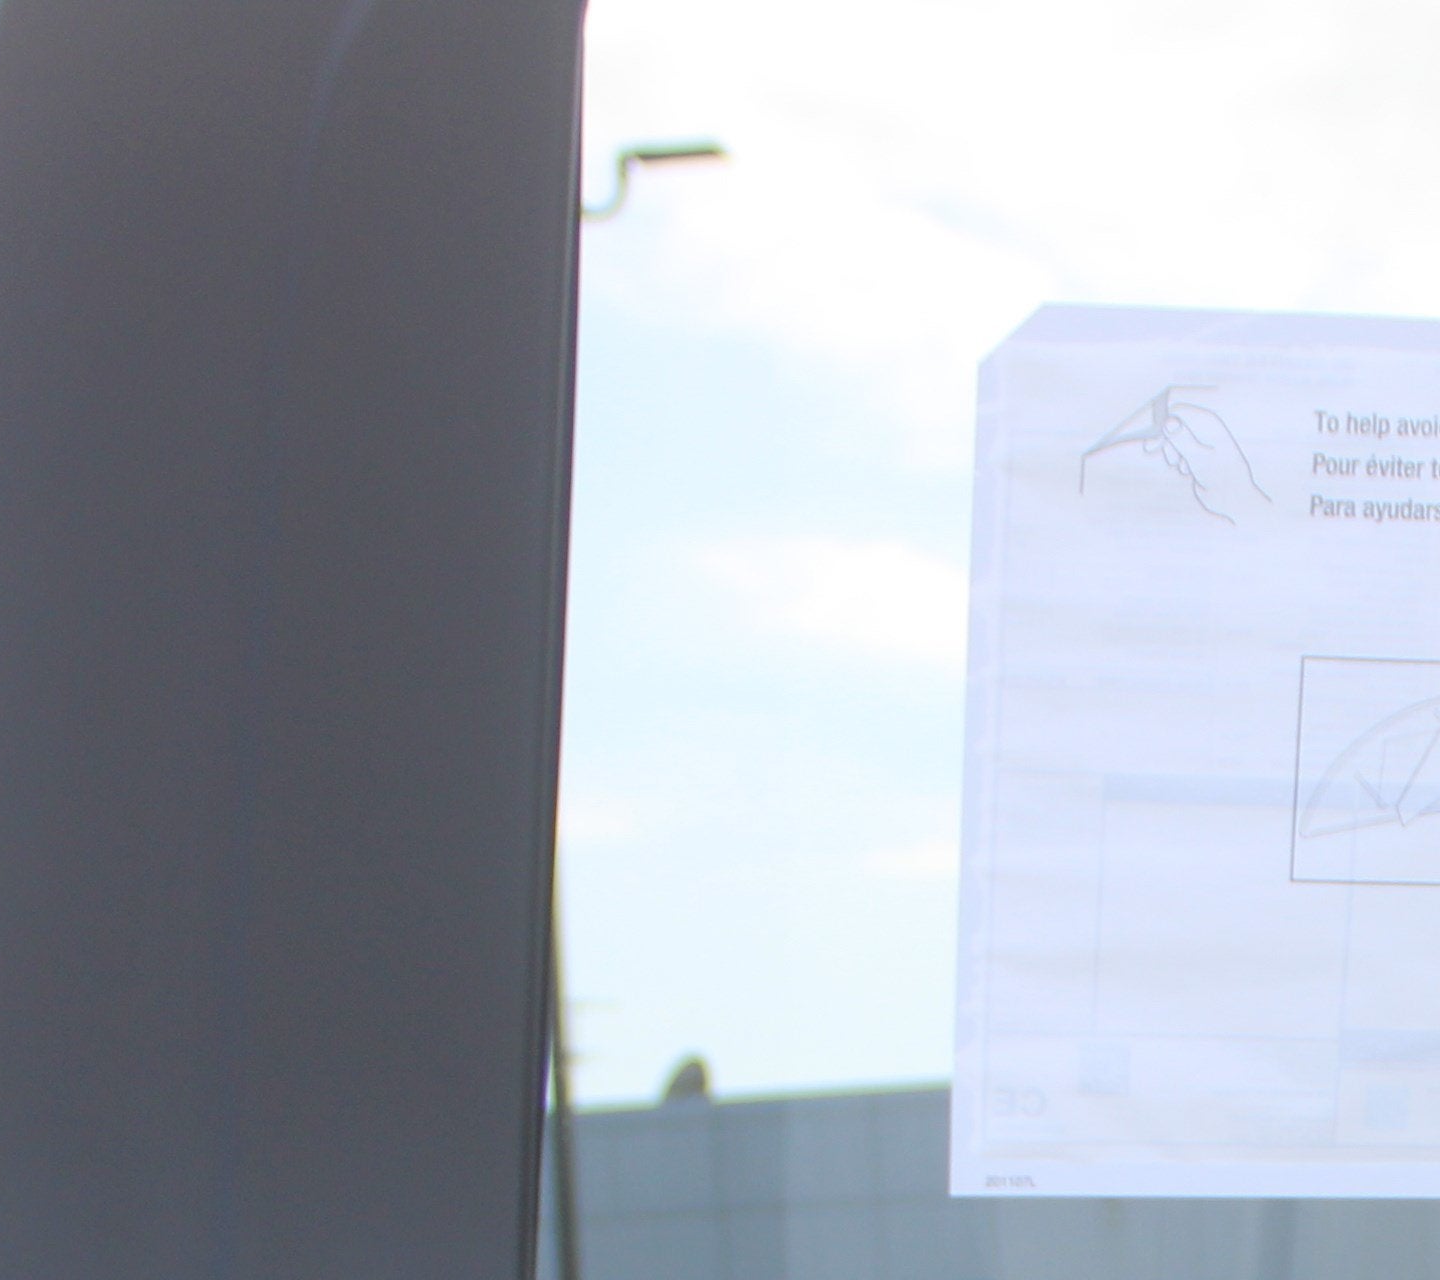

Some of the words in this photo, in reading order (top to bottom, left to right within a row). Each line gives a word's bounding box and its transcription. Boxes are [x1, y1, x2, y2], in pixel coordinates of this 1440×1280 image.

[1315, 411, 1340, 434] To
[1346, 413, 1390, 438] help
[1312, 454, 1360, 477] Pour
[1366, 455, 1424, 480] éviter
[1310, 496, 1356, 519] Para
